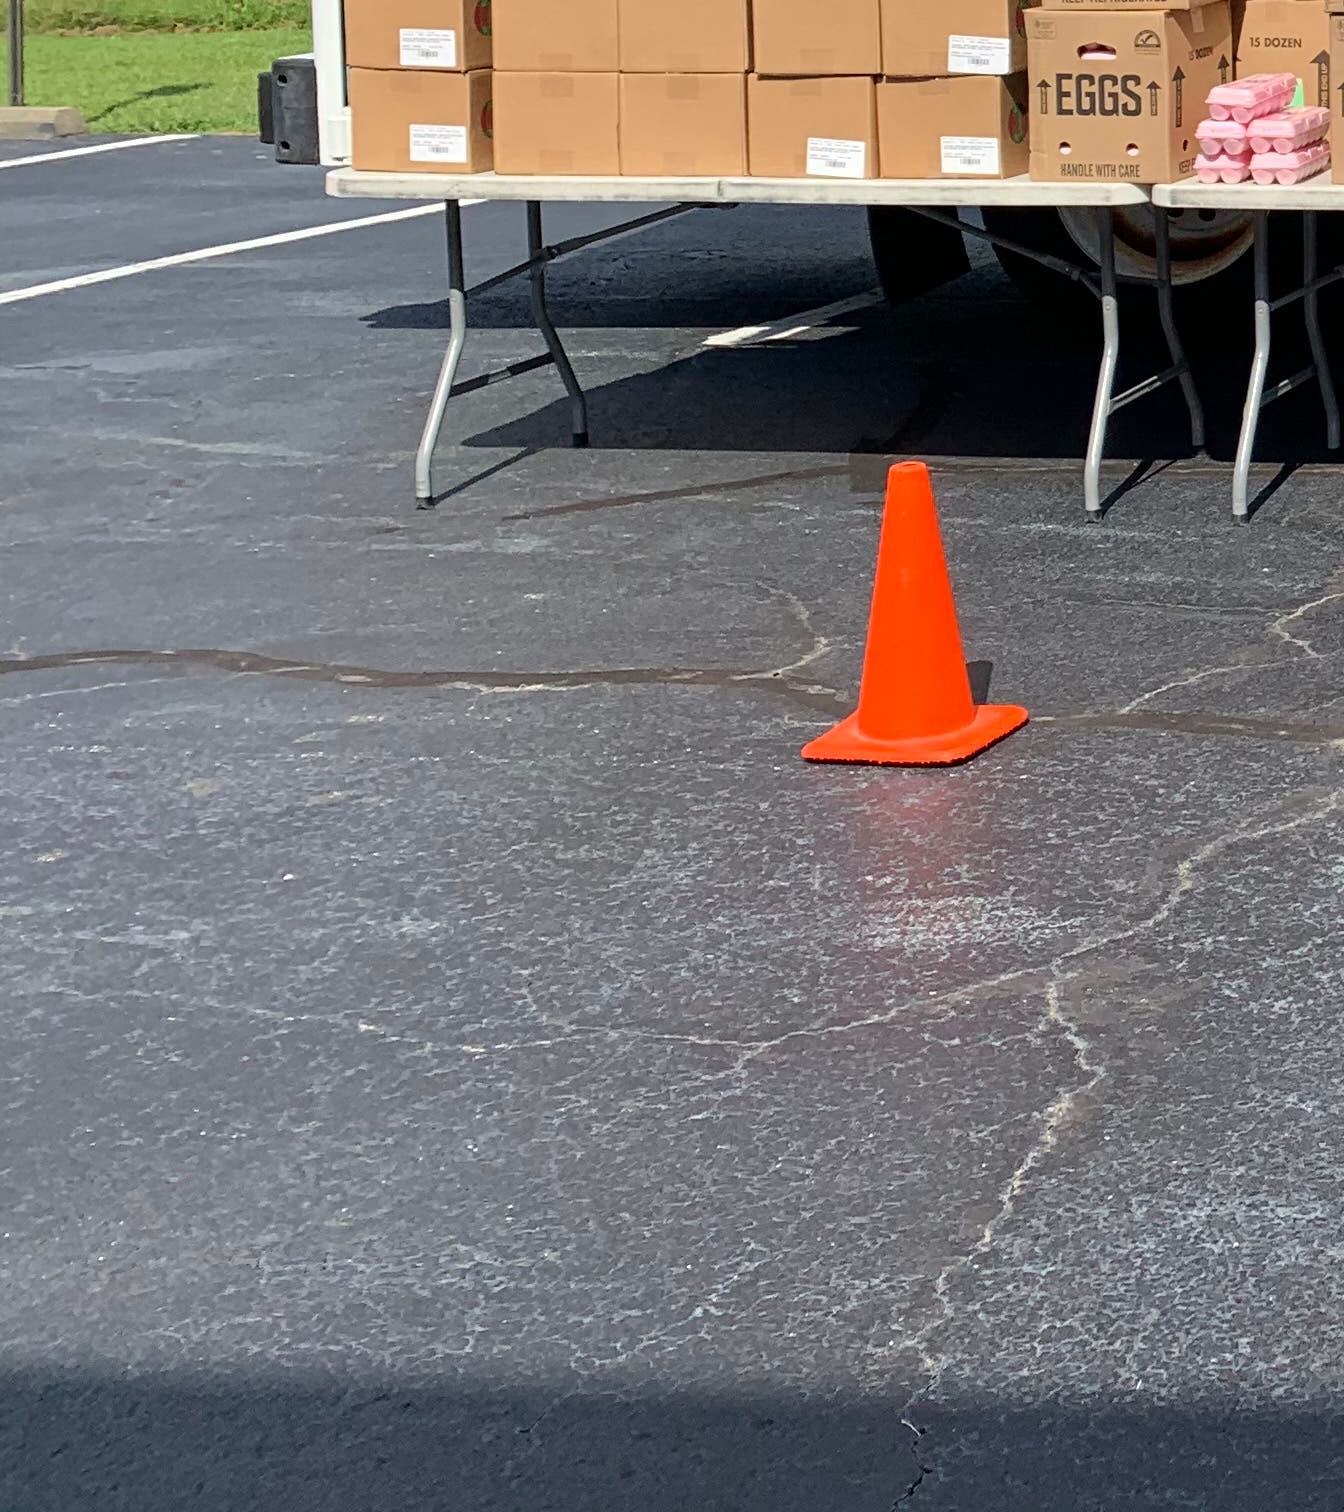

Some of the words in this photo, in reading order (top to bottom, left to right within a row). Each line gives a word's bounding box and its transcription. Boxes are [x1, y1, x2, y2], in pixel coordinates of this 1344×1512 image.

[1250, 37, 1261, 48] 15
[1264, 37, 1302, 48] DOZEN
[1055, 73, 1142, 116] EGGS
[1060, 163, 1094, 177] HANDLE
[1095, 164, 1117, 177] WITH
[1118, 164, 1141, 178] CARE
